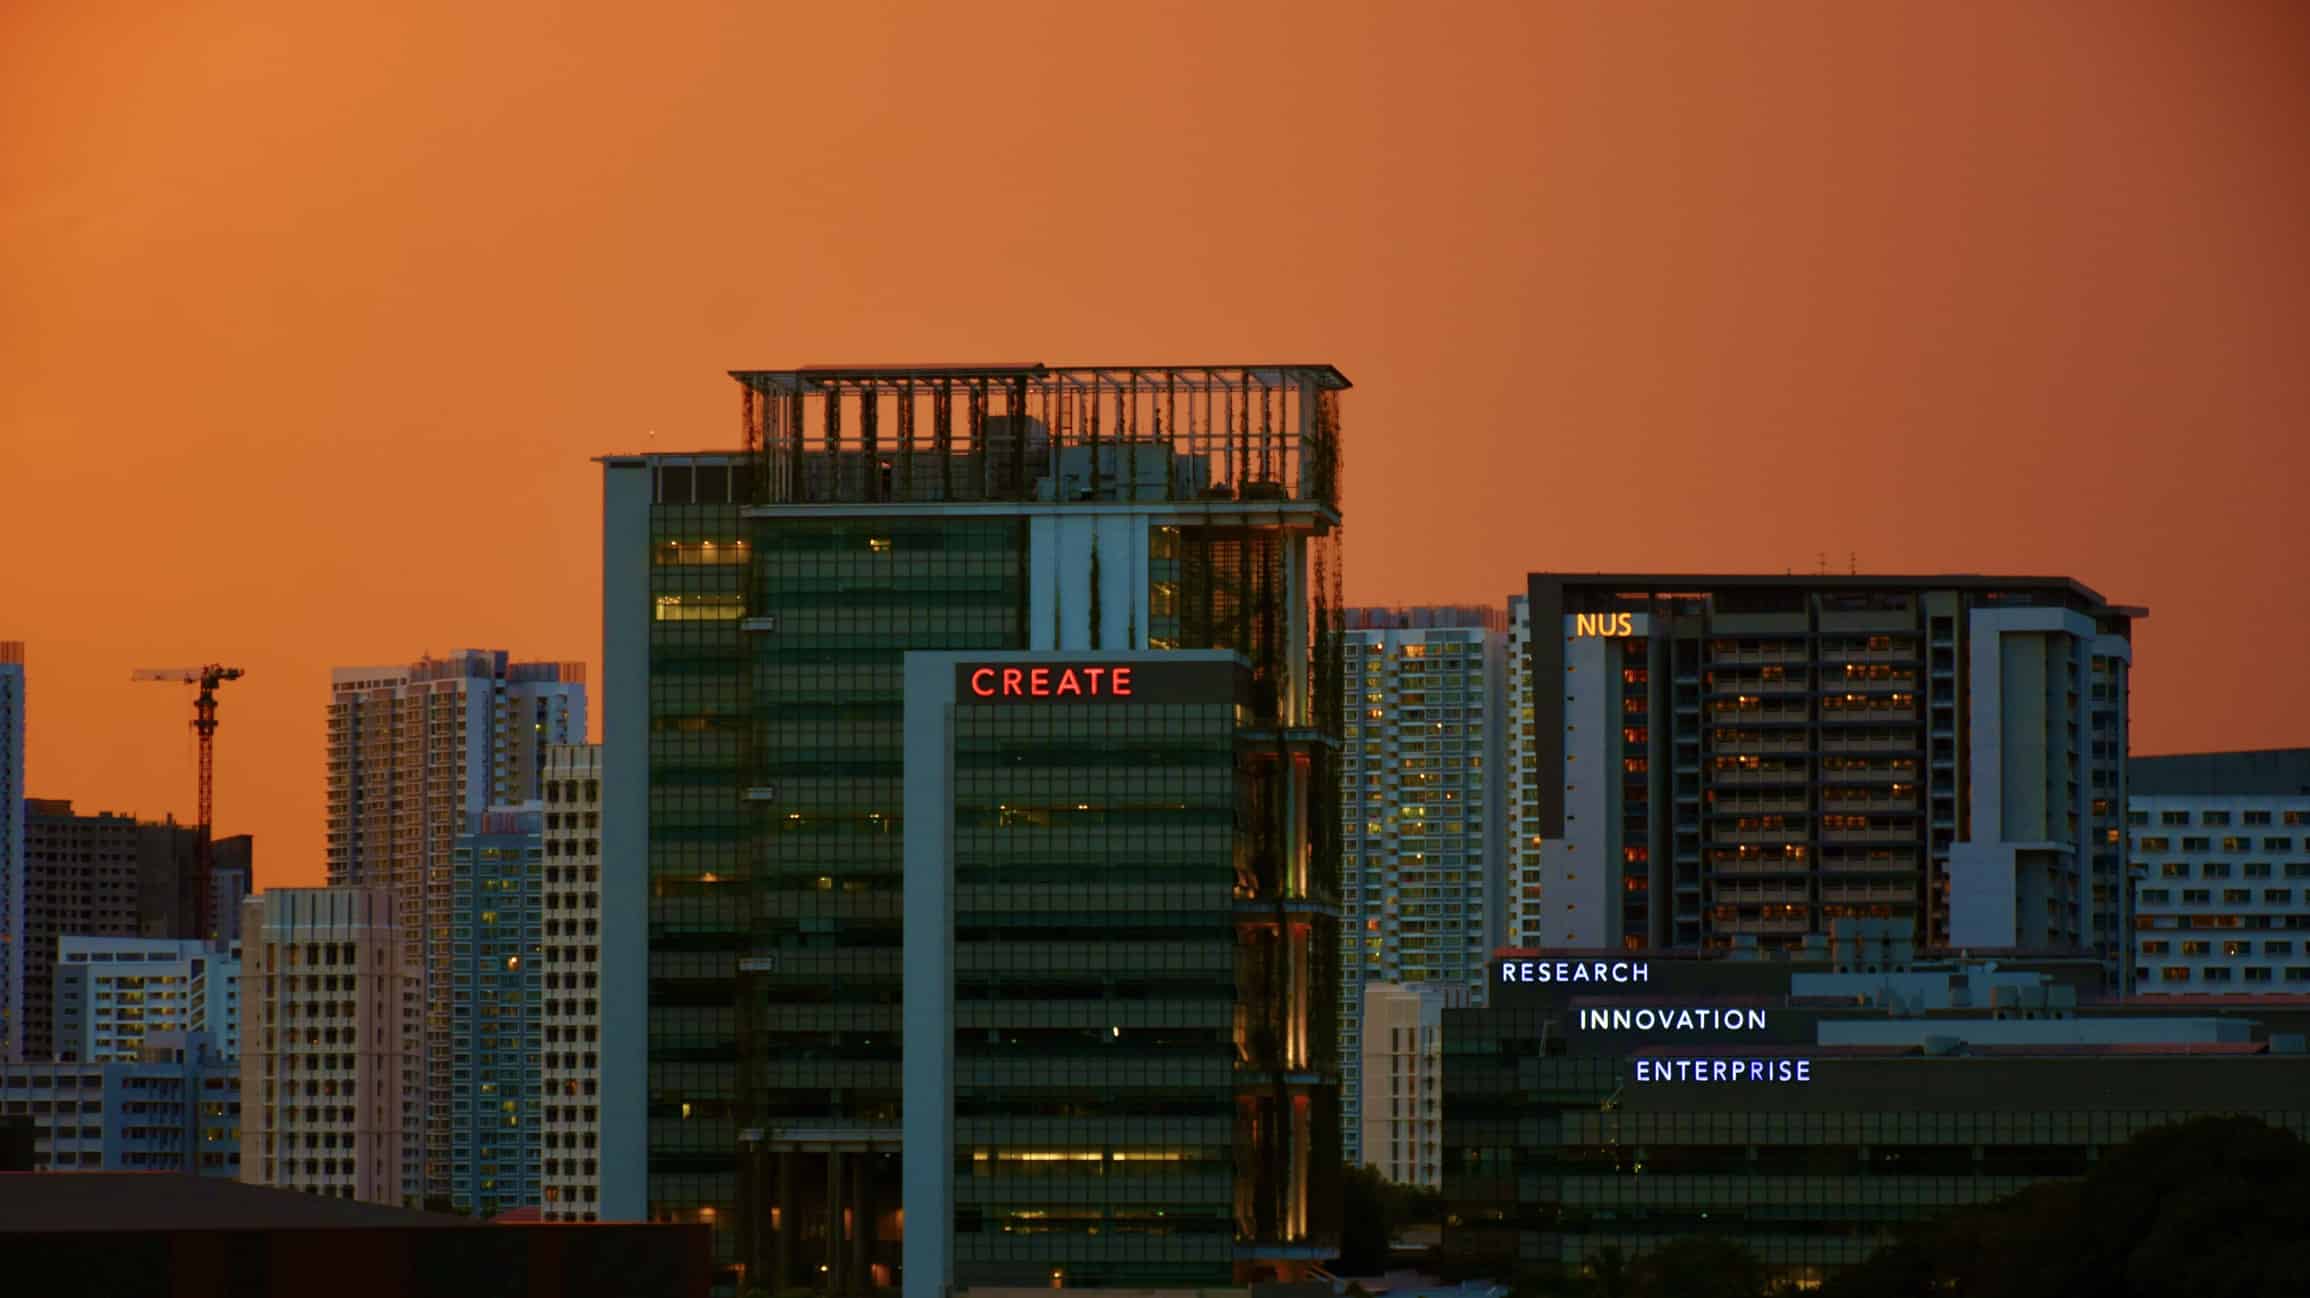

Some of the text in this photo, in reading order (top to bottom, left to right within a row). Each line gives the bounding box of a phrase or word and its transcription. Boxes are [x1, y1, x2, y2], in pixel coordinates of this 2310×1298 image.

[1577, 612, 1632, 637] NUS
[971, 668, 1131, 696] CREATE
[1502, 962, 1648, 982] RESEARCH
[1580, 1009, 1766, 1030] INNOVATION
[1636, 1060, 1811, 1081] ENTERPRISE
